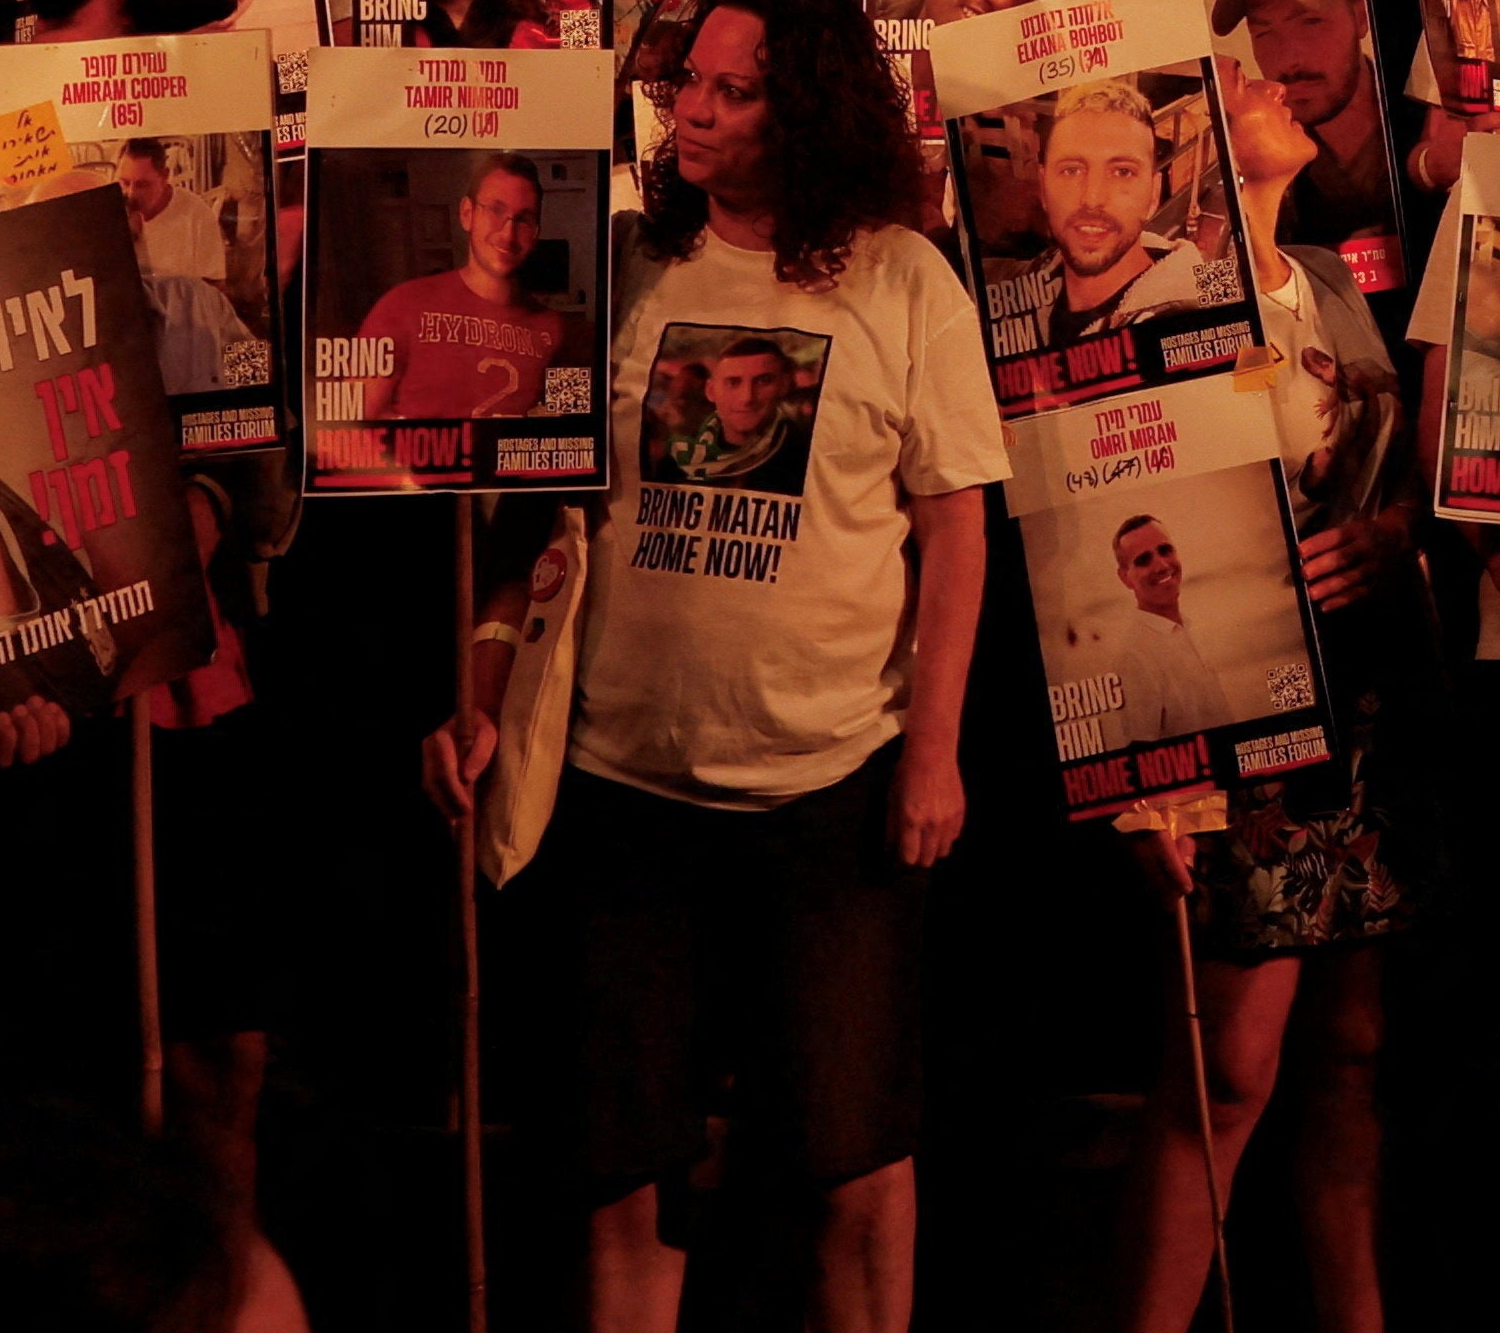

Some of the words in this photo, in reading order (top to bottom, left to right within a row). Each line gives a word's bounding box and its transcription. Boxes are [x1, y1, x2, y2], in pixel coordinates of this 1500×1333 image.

[1017, 34, 1066, 64] ELKANA
[1069, 21, 1124, 48] BOHBOT
[81, 54, 118, 79] קופר
[123, 52, 167, 75] עמירם
[62, 79, 127, 104] AMIRAM
[131, 78, 188, 101] COOPER
[404, 85, 454, 108] TAMIR
[457, 85, 518, 109] NIMRODI
[111, 101, 143, 128] (85)
[316, 337, 394, 378] BRING
[1163, 346, 1212, 368] FAMILIES
[1214, 334, 1254, 357] FORUM
[35, 363, 122, 460] אין
[316, 381, 365, 420] HIM
[394, 423, 471, 465] NOW!
[497, 451, 546, 470] FAMILIES
[552, 450, 594, 468] FORUM
[1090, 432, 1127, 459] OMRI
[1130, 421, 1177, 451] MIRAN
[30, 450, 137, 550] זמן!
[636, 488, 703, 530] BRING
[708, 494, 801, 541] MATAN
[631, 532, 701, 574] HOME
[704, 537, 781, 583] NOW!
[22, 609, 72, 655] אותו
[1048, 673, 1124, 722] BRING
[1057, 718, 1104, 761] HIM
[1238, 747, 1286, 774] FAMILIES
[1288, 738, 1328, 761] FORUM
[1139, 734, 1210, 787] NOW!
